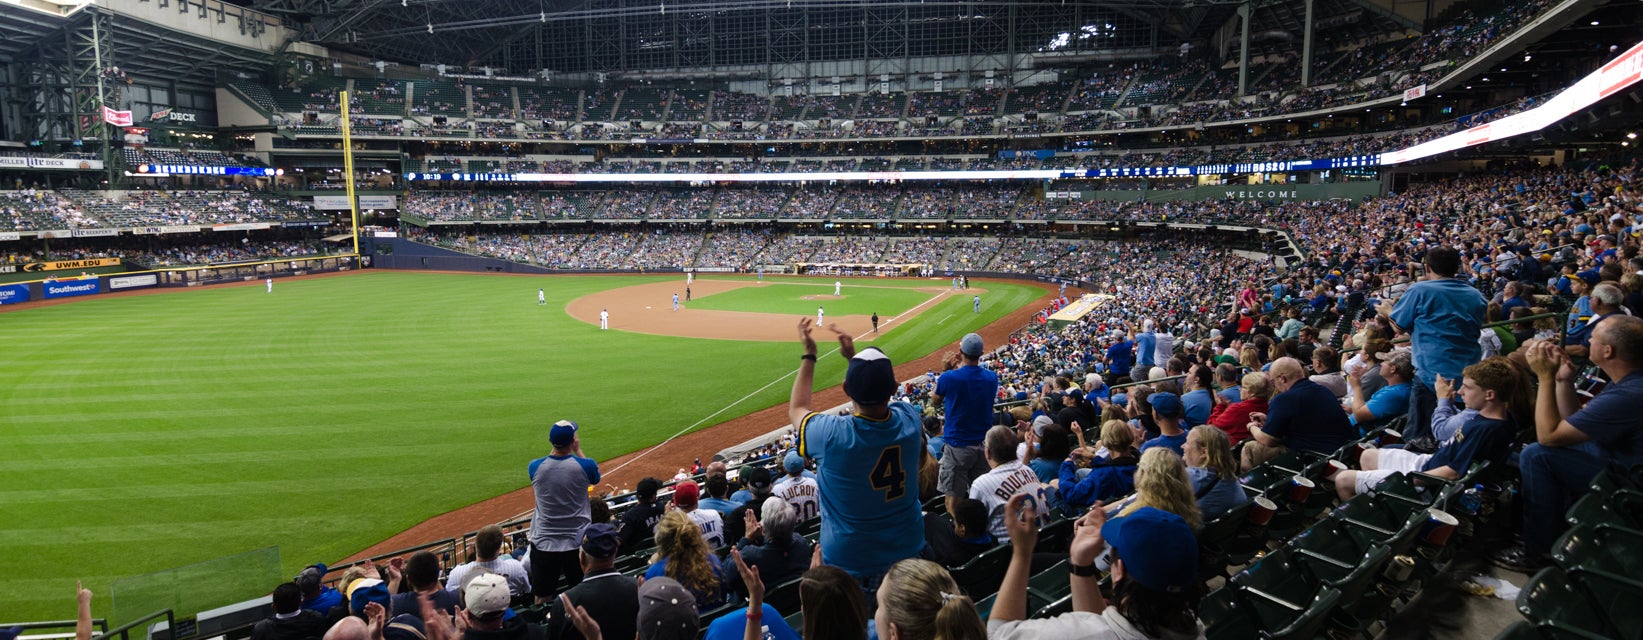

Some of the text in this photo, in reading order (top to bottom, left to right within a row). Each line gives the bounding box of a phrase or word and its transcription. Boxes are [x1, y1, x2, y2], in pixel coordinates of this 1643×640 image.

[170, 111, 196, 121] DECK
[1225, 190, 1297, 198] WELCOME
[56, 259, 101, 269] UWM.EDU
[49, 284, 91, 294] Southwest
[868, 444, 907, 503] 4
[781, 484, 816, 501] LUCROY
